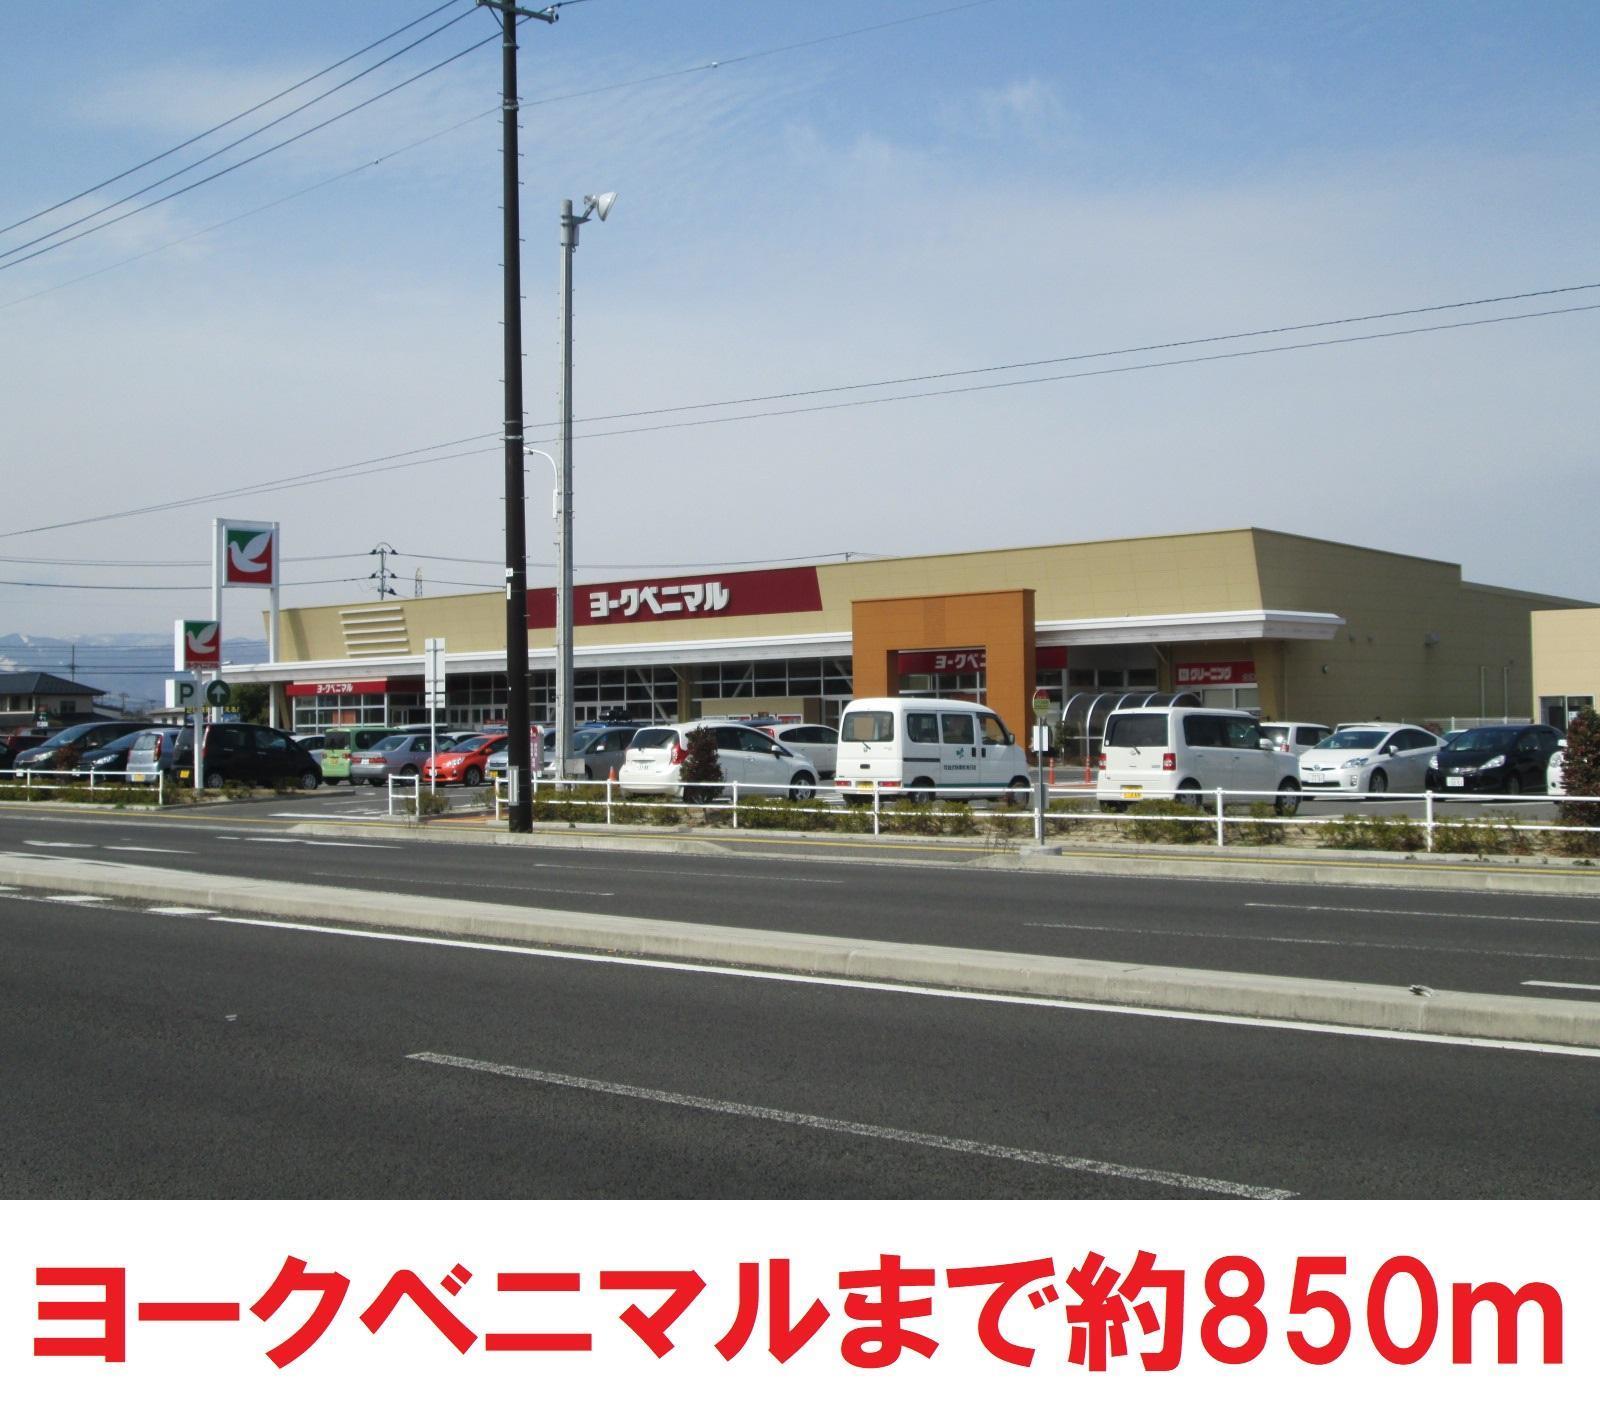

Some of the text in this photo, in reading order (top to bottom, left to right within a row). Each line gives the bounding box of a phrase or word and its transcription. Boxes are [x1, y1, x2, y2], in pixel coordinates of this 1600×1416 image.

[589, 582, 729, 618] ヨークベニマル
[180, 683, 194, 704] P
[316, 683, 353, 694] ヨークベニマル
